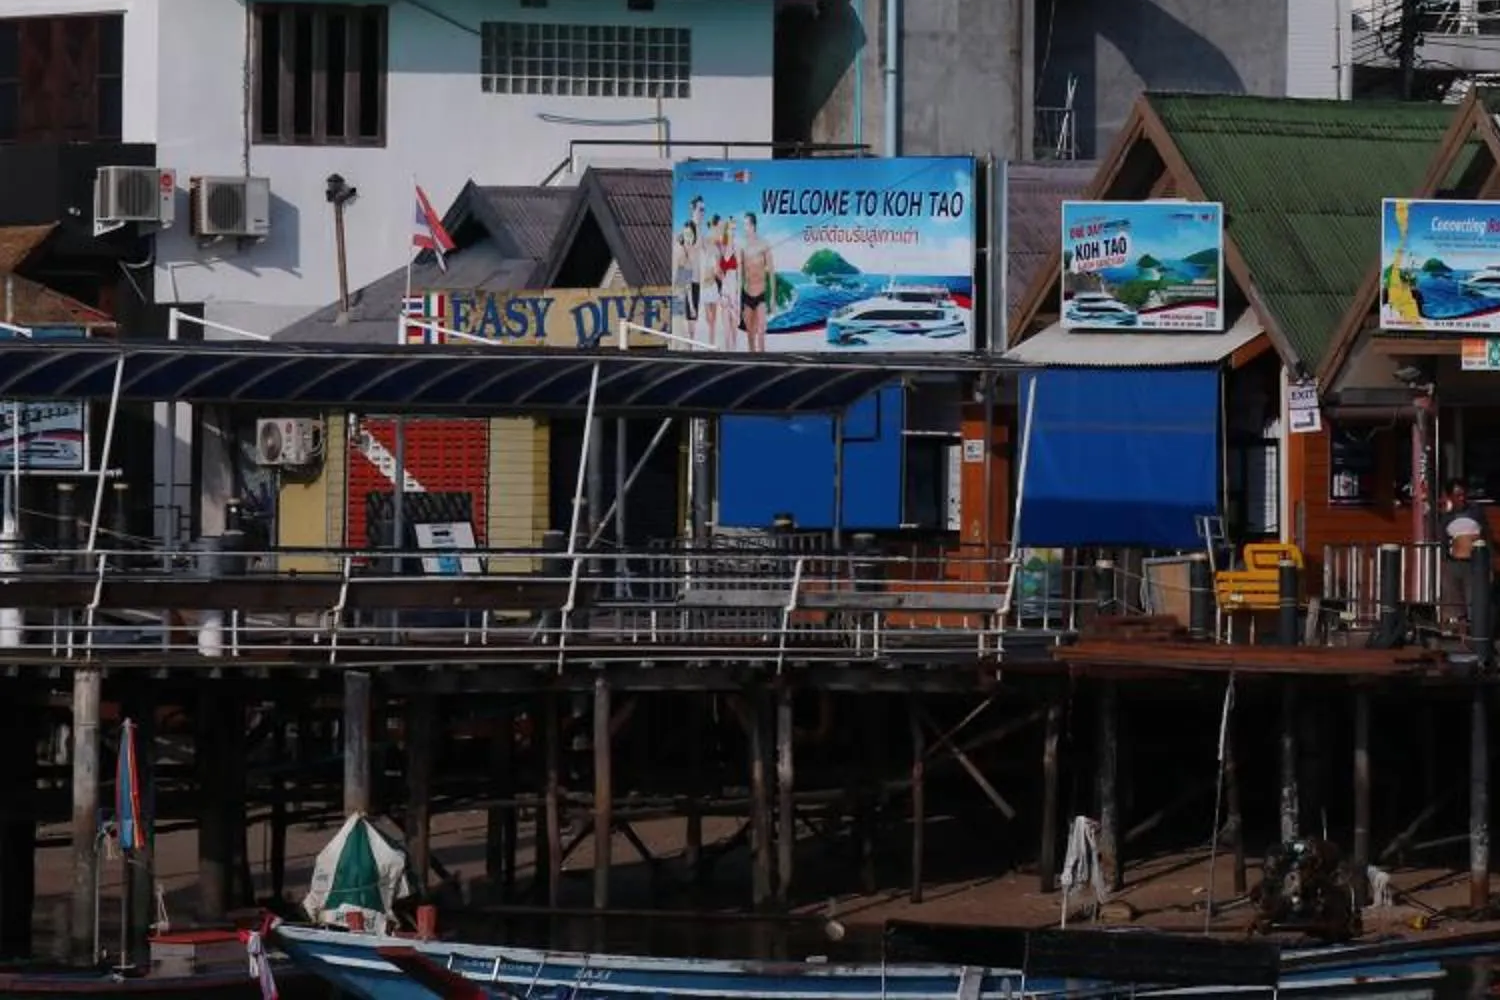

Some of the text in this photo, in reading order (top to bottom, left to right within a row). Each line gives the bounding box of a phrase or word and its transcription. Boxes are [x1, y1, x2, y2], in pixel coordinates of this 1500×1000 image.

[762, 189, 964, 217] WELCOME TO KOH TAO
[1075, 236, 1127, 261] KOH TAO
[450, 291, 673, 349] EASY DIVE
[1291, 390, 1314, 401] EXIT
